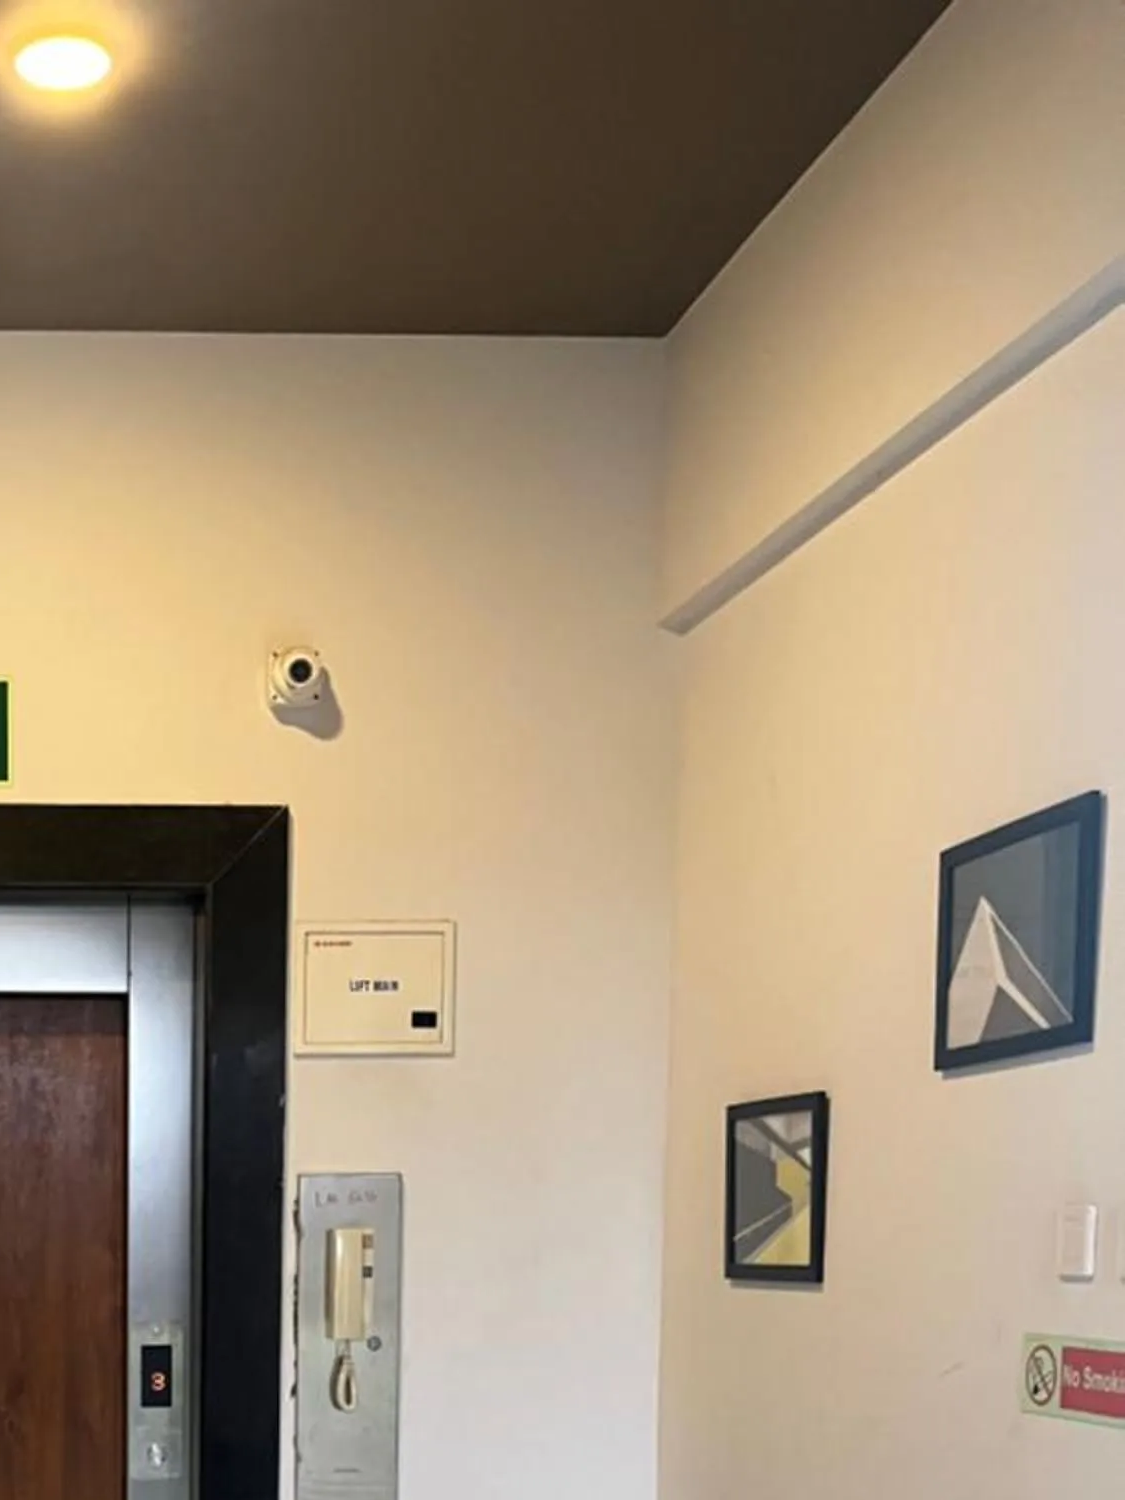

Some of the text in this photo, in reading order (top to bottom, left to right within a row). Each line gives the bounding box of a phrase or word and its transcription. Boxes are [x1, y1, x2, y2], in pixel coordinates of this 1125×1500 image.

[349, 980, 370, 992] LIFT
[151, 1371, 166, 1392] 3
[1064, 1364, 1080, 1388] No
